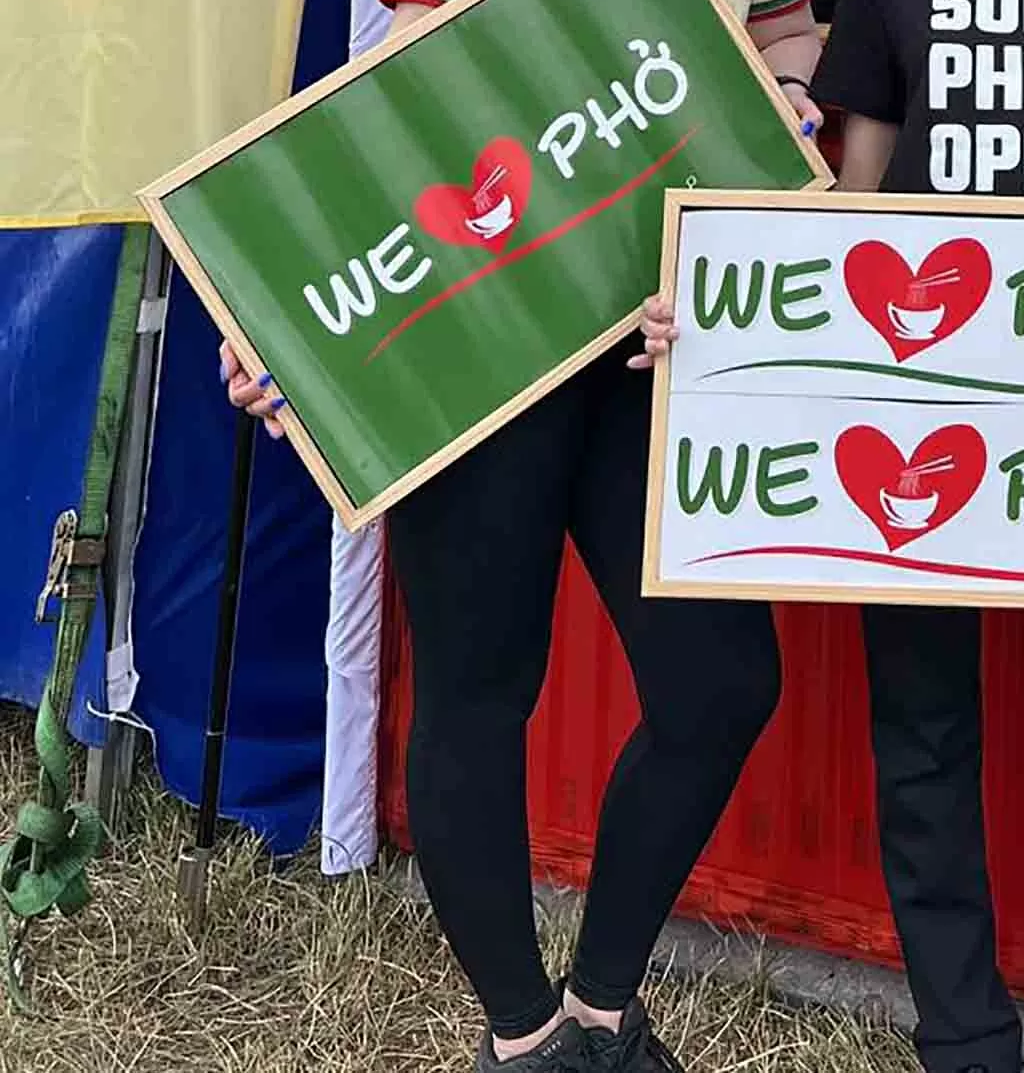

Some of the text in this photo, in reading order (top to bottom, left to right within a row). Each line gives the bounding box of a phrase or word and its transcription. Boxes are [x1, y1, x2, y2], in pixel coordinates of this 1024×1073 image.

[302, 38, 689, 336] WE PHỞ
[692, 254, 833, 332] WE
[676, 436, 820, 518] WE
